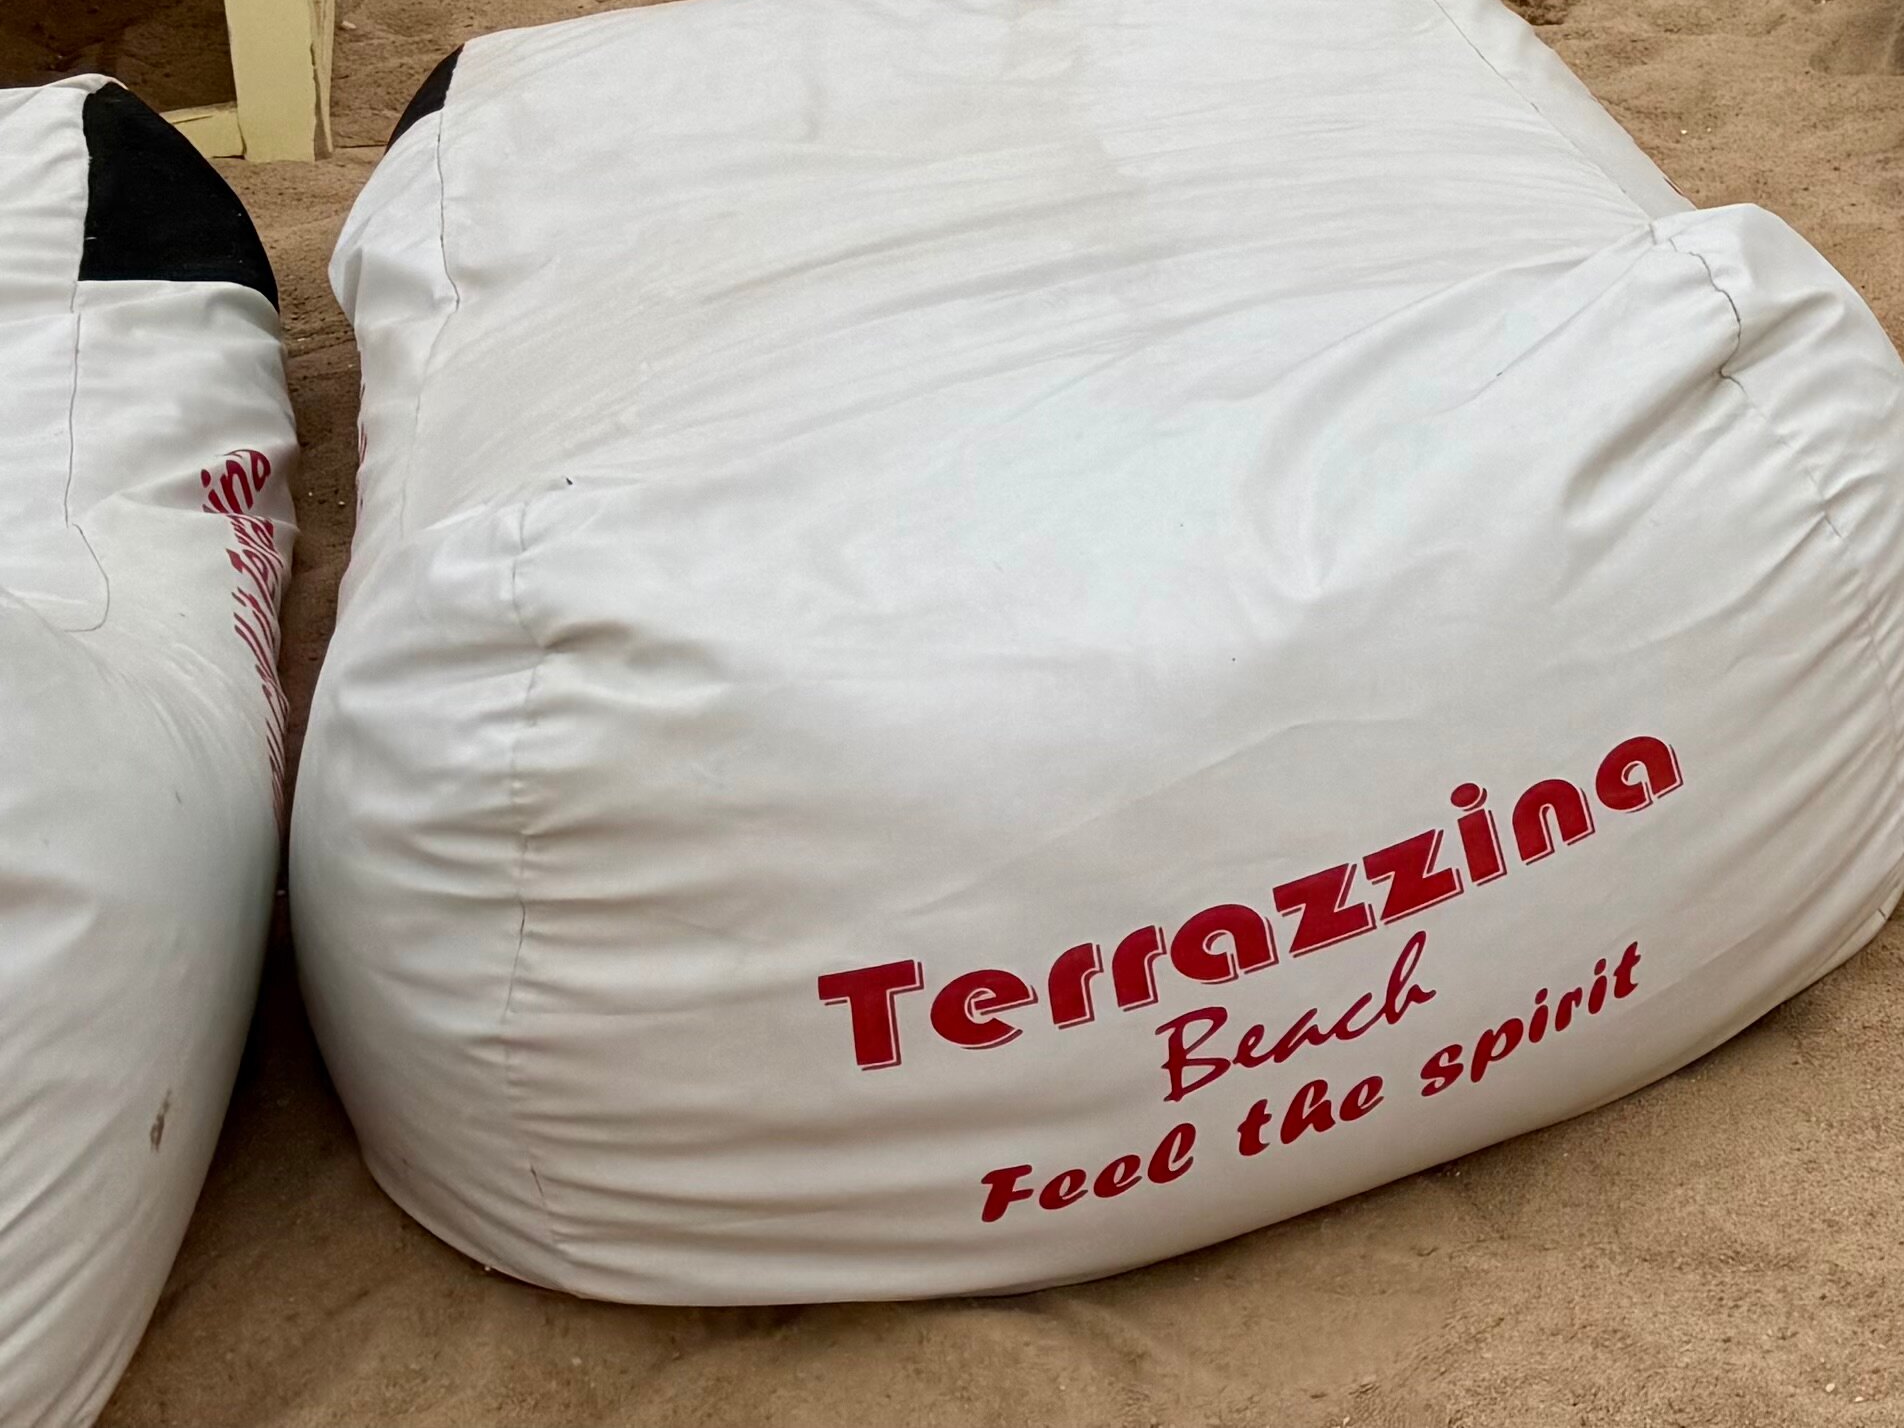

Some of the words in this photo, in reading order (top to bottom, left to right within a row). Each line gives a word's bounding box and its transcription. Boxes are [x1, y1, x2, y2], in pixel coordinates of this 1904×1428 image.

[817, 735, 1684, 1072] Terrazzina
[1154, 930, 1437, 1103] Beach
[980, 1123, 1196, 1224] Feel
[1236, 1073, 1384, 1158] the
[1418, 940, 1642, 1099] spirit
